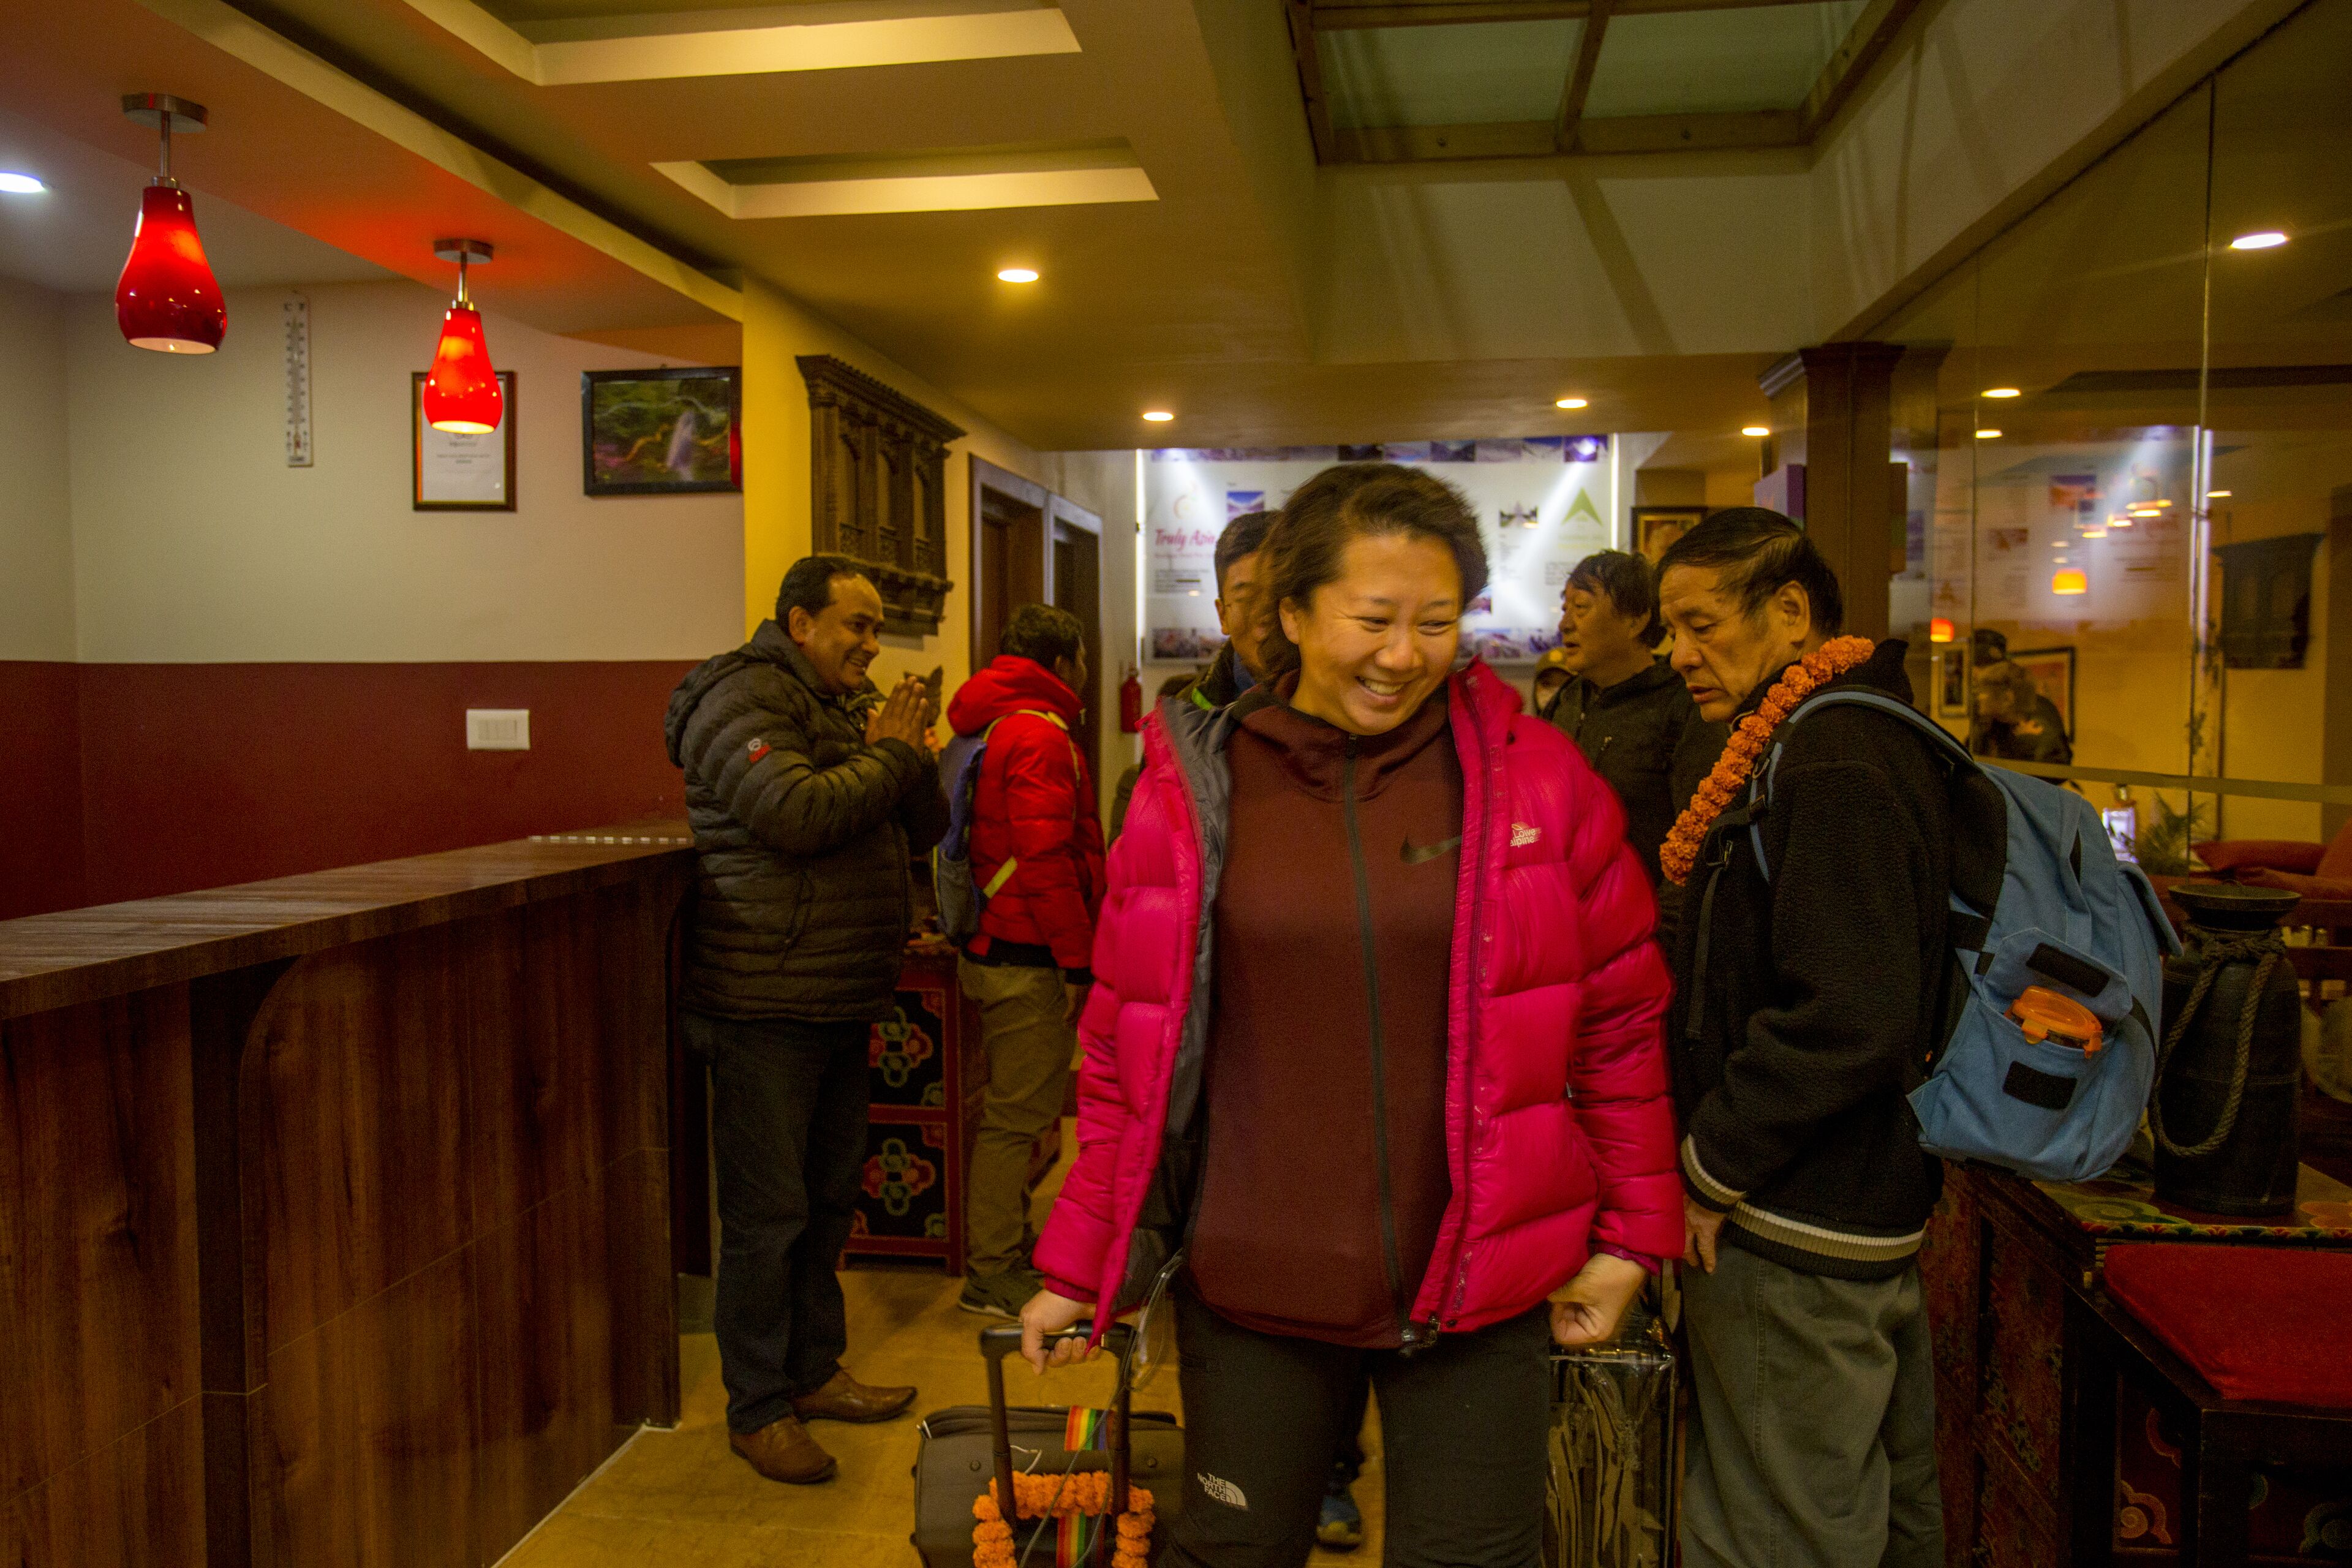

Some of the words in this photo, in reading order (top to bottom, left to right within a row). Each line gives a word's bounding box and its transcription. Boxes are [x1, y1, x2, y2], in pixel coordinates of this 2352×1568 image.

[1155, 527, 1186, 552] Truly
[1512, 829, 1536, 838] Lowe
[1510, 836, 1534, 848] alpine
[1197, 1472, 1226, 1494] NORTH
[1207, 1472, 1226, 1487] THE
[1204, 1485, 1226, 1501] FACE
